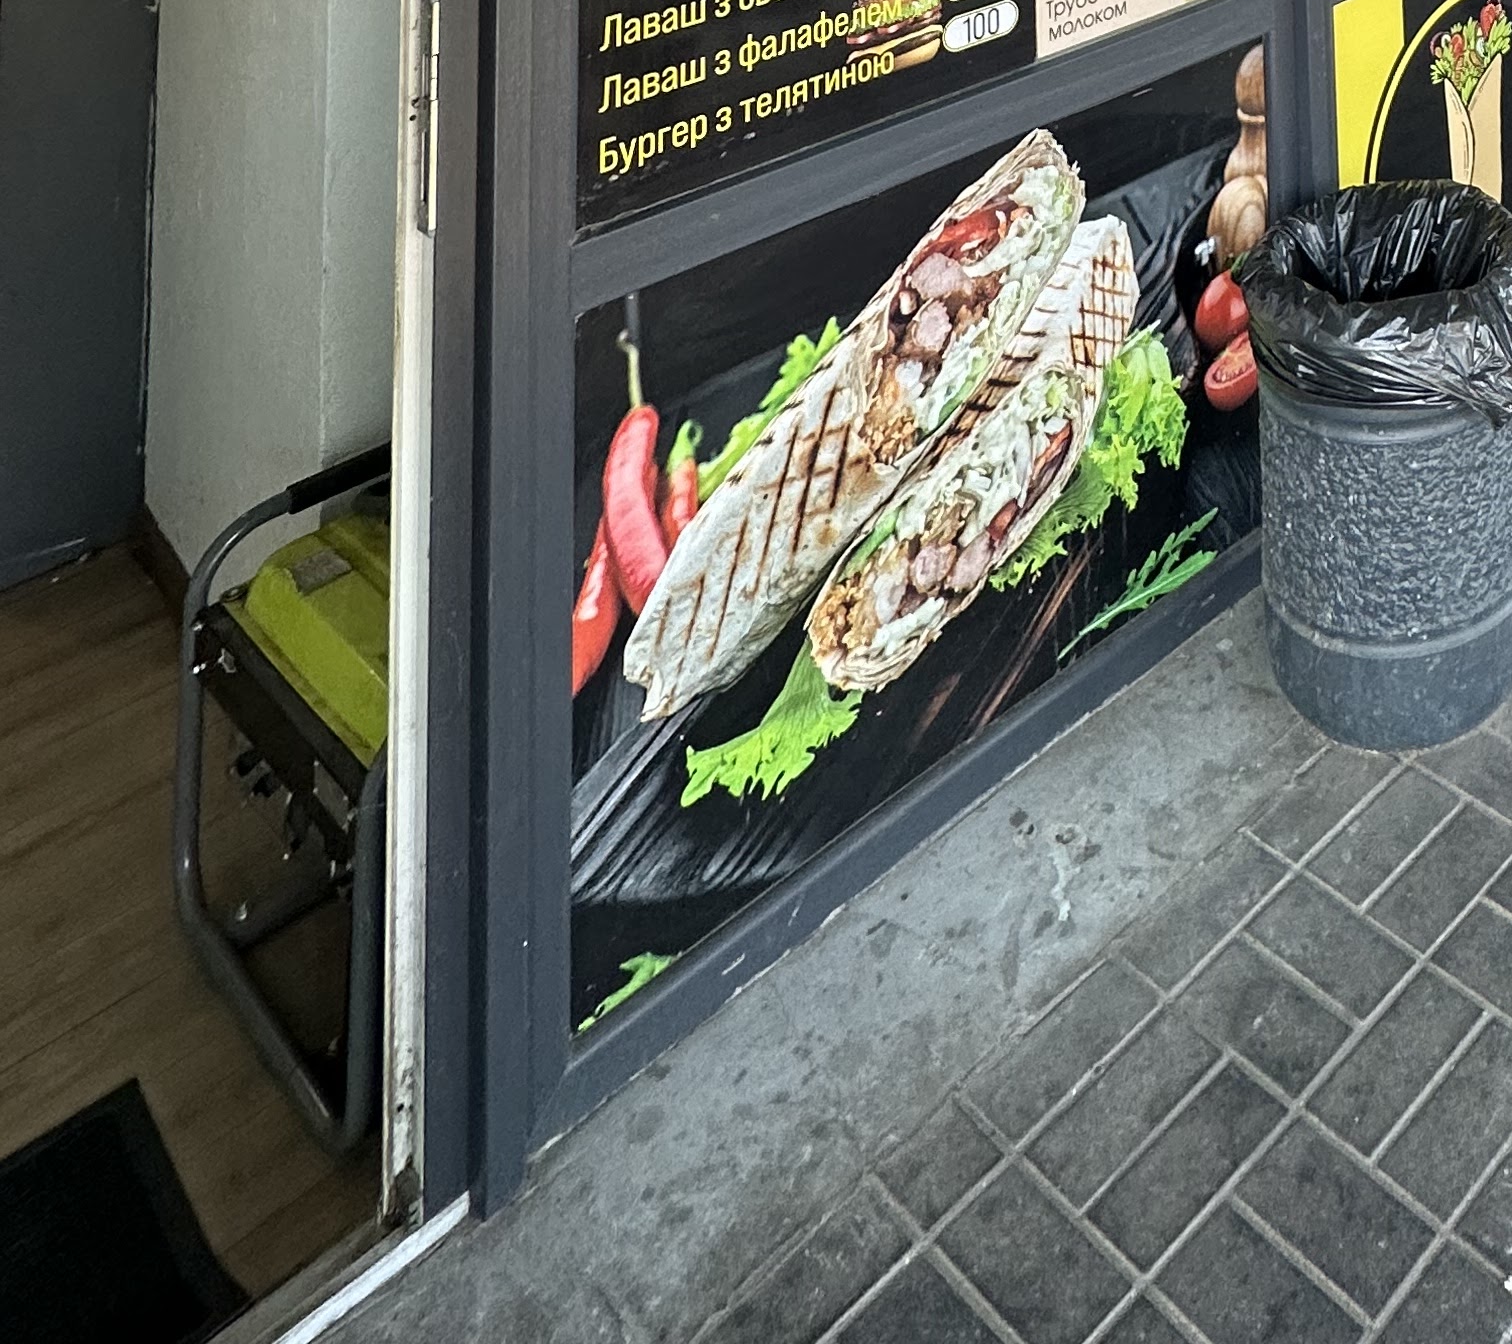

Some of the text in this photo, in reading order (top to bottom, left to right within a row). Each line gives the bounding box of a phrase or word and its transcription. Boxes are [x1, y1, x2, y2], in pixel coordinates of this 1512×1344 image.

[600, 0, 707, 51] Лаваш
[964, 9, 999, 40] 100
[1049, 1, 1127, 41] молоком
[599, 0, 903, 112] Лаваш з фалафелем
[599, 51, 894, 174] Бургер з телятиною
